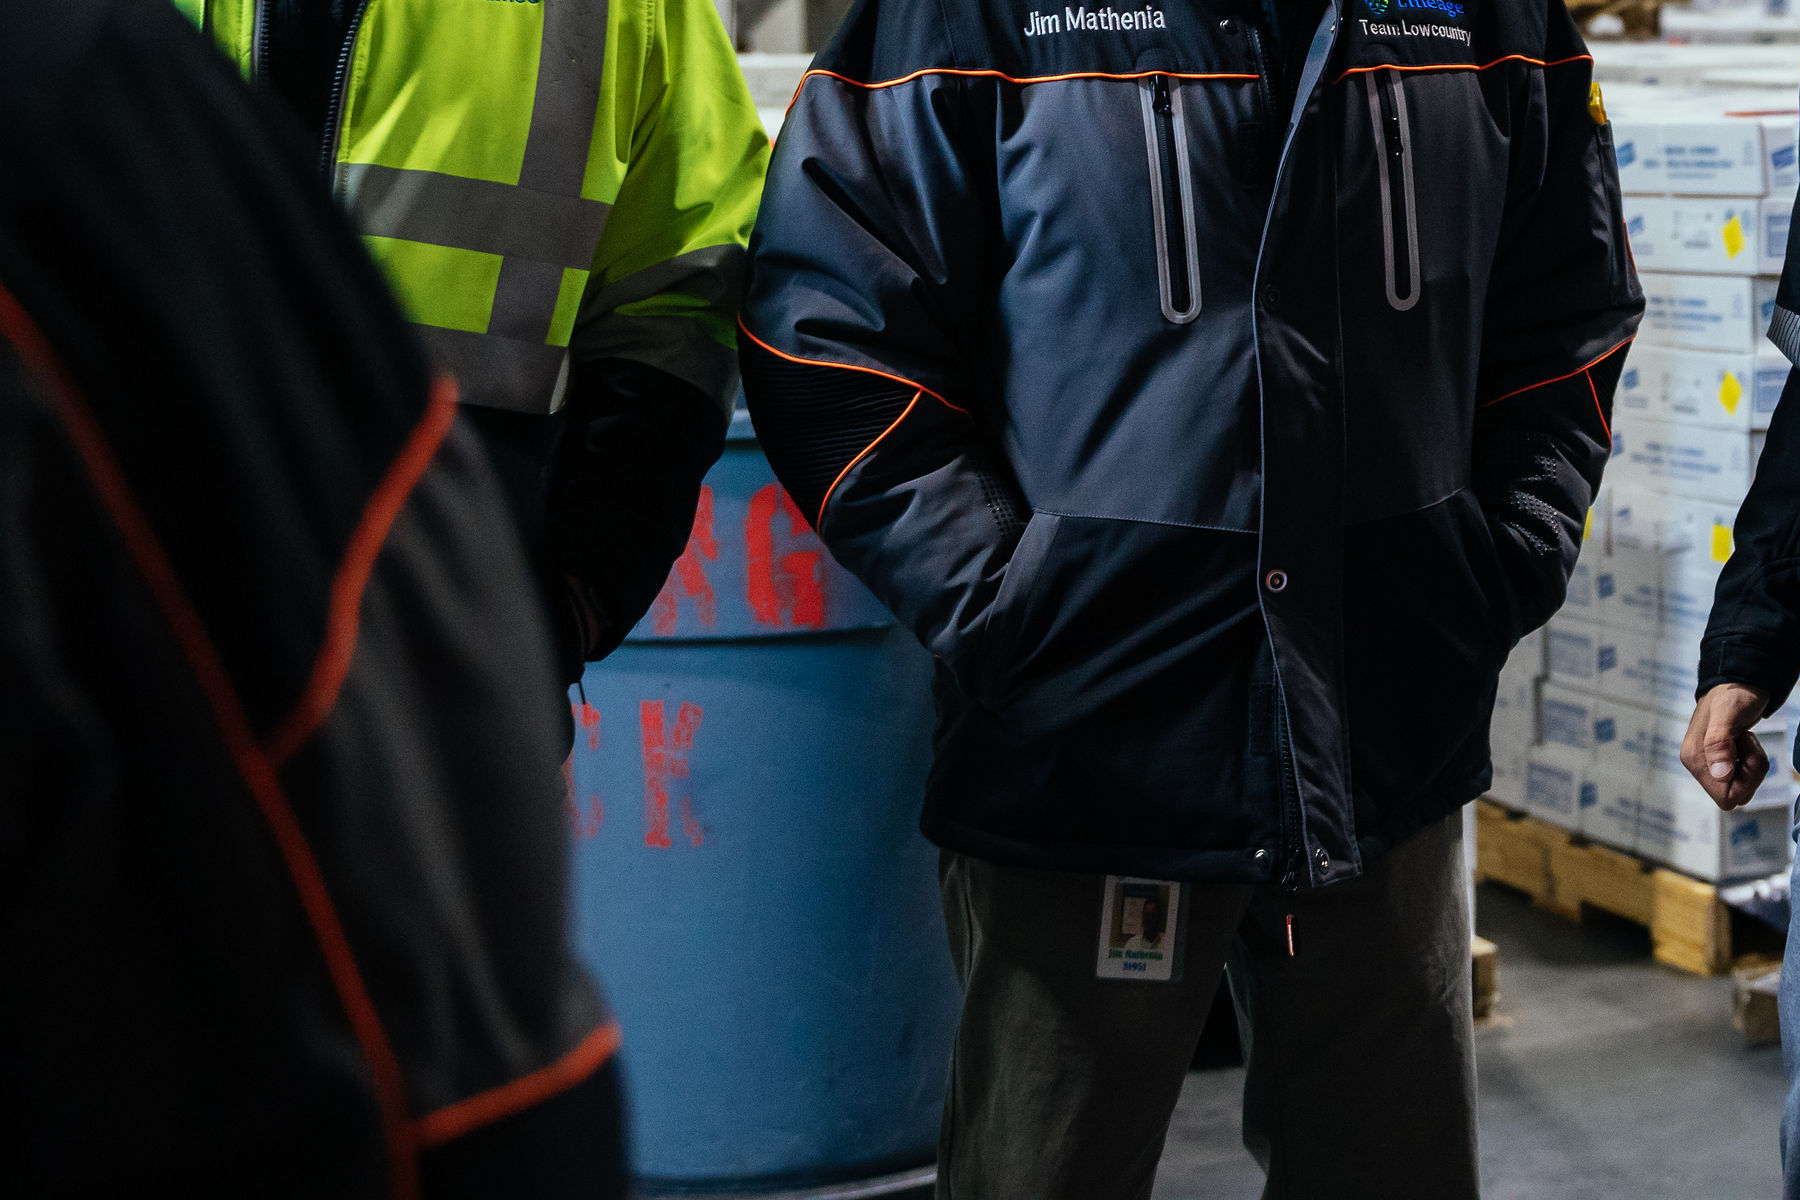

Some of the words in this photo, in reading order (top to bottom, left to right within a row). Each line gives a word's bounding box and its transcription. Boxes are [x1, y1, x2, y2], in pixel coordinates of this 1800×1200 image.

[1024, 10, 1060, 37] Jim
[1065, 4, 1167, 33] Mathenia
[1359, 18, 1401, 37] Team
